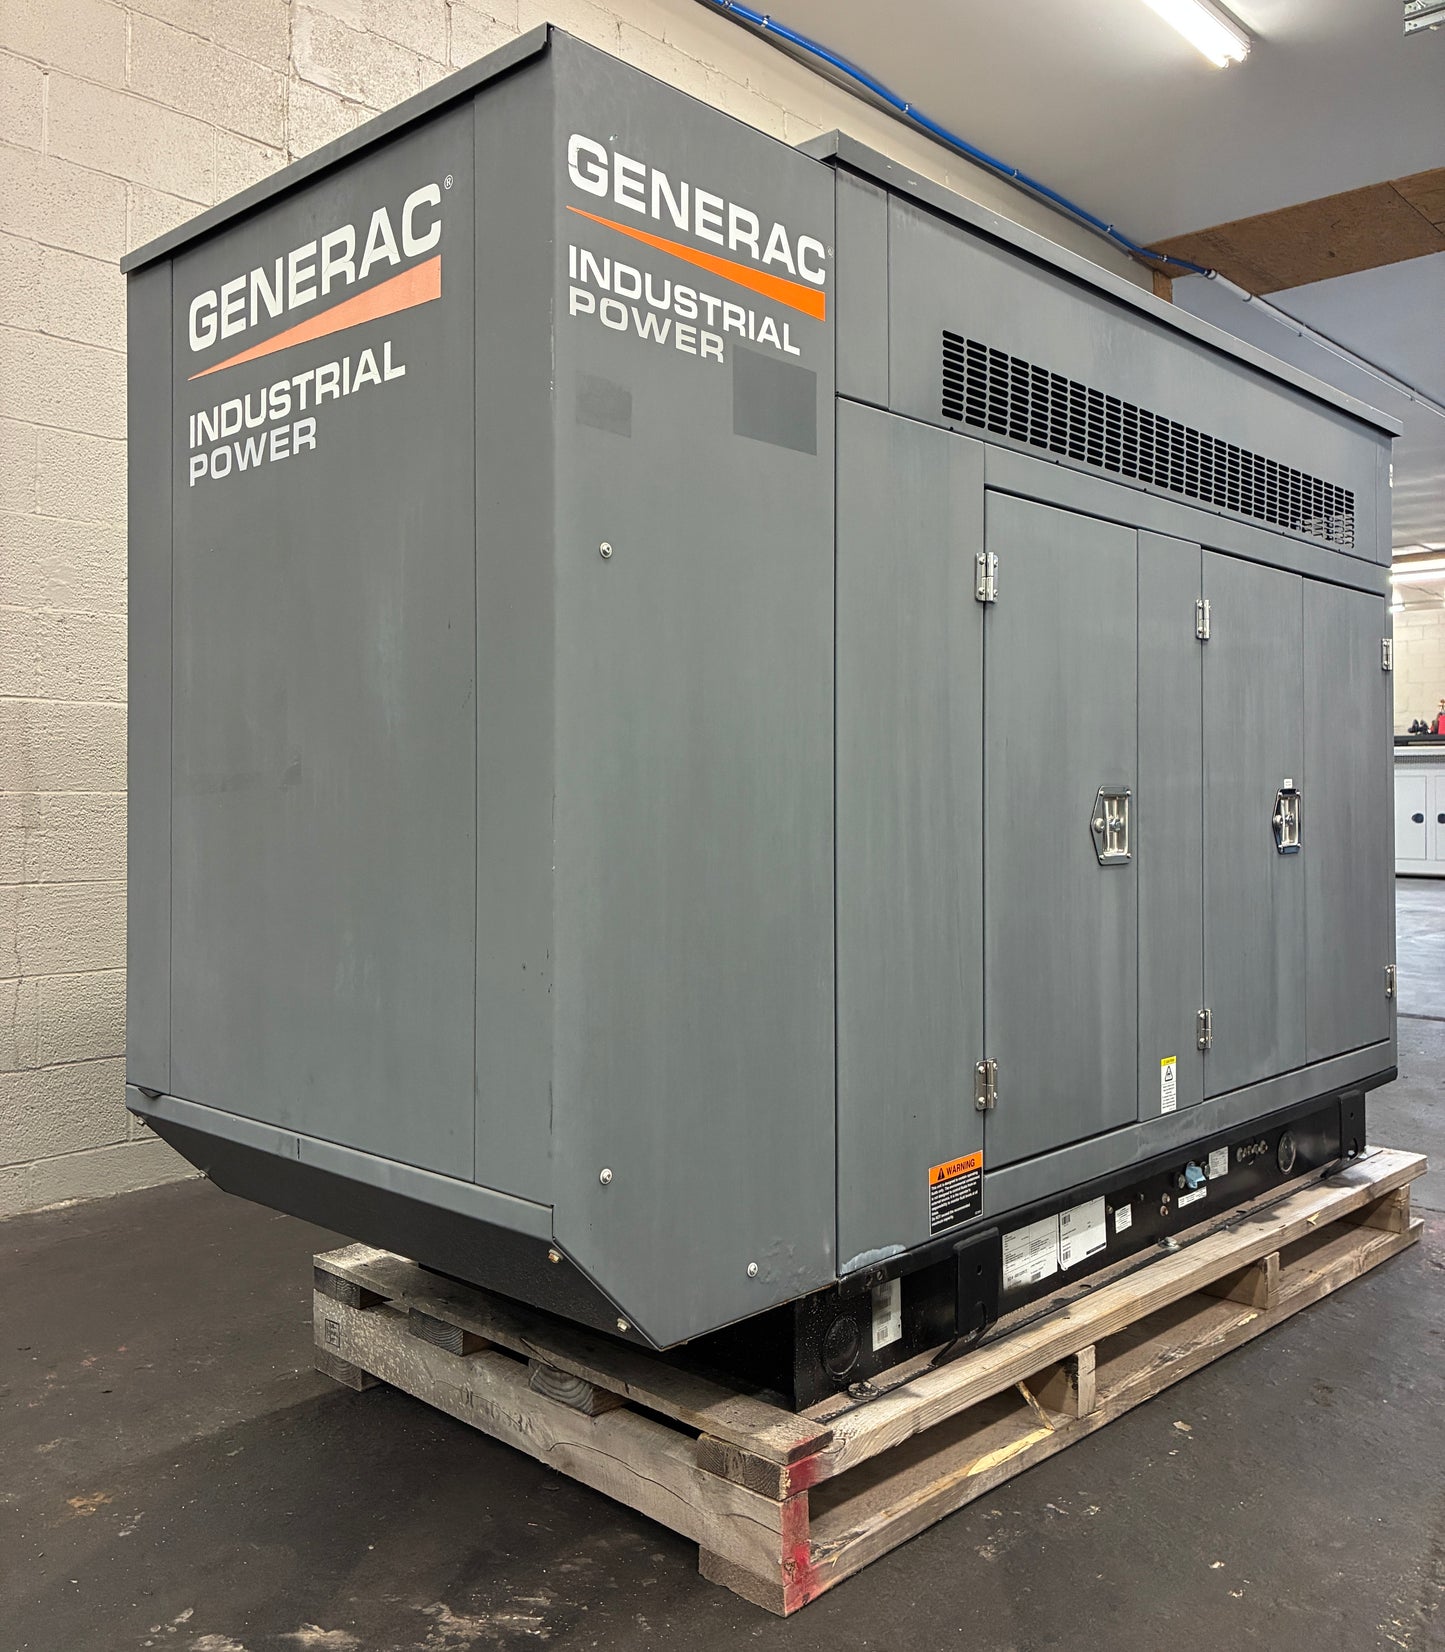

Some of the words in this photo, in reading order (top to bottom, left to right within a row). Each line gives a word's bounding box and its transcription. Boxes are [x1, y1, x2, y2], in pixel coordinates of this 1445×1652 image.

[568, 244, 801, 357] INDUSTRIAL
[568, 284, 726, 365] POWER
[188, 341, 406, 449] INDUSTRIAL
[189, 416, 317, 488] POWER
[946, 1158, 976, 1175] WARNING
